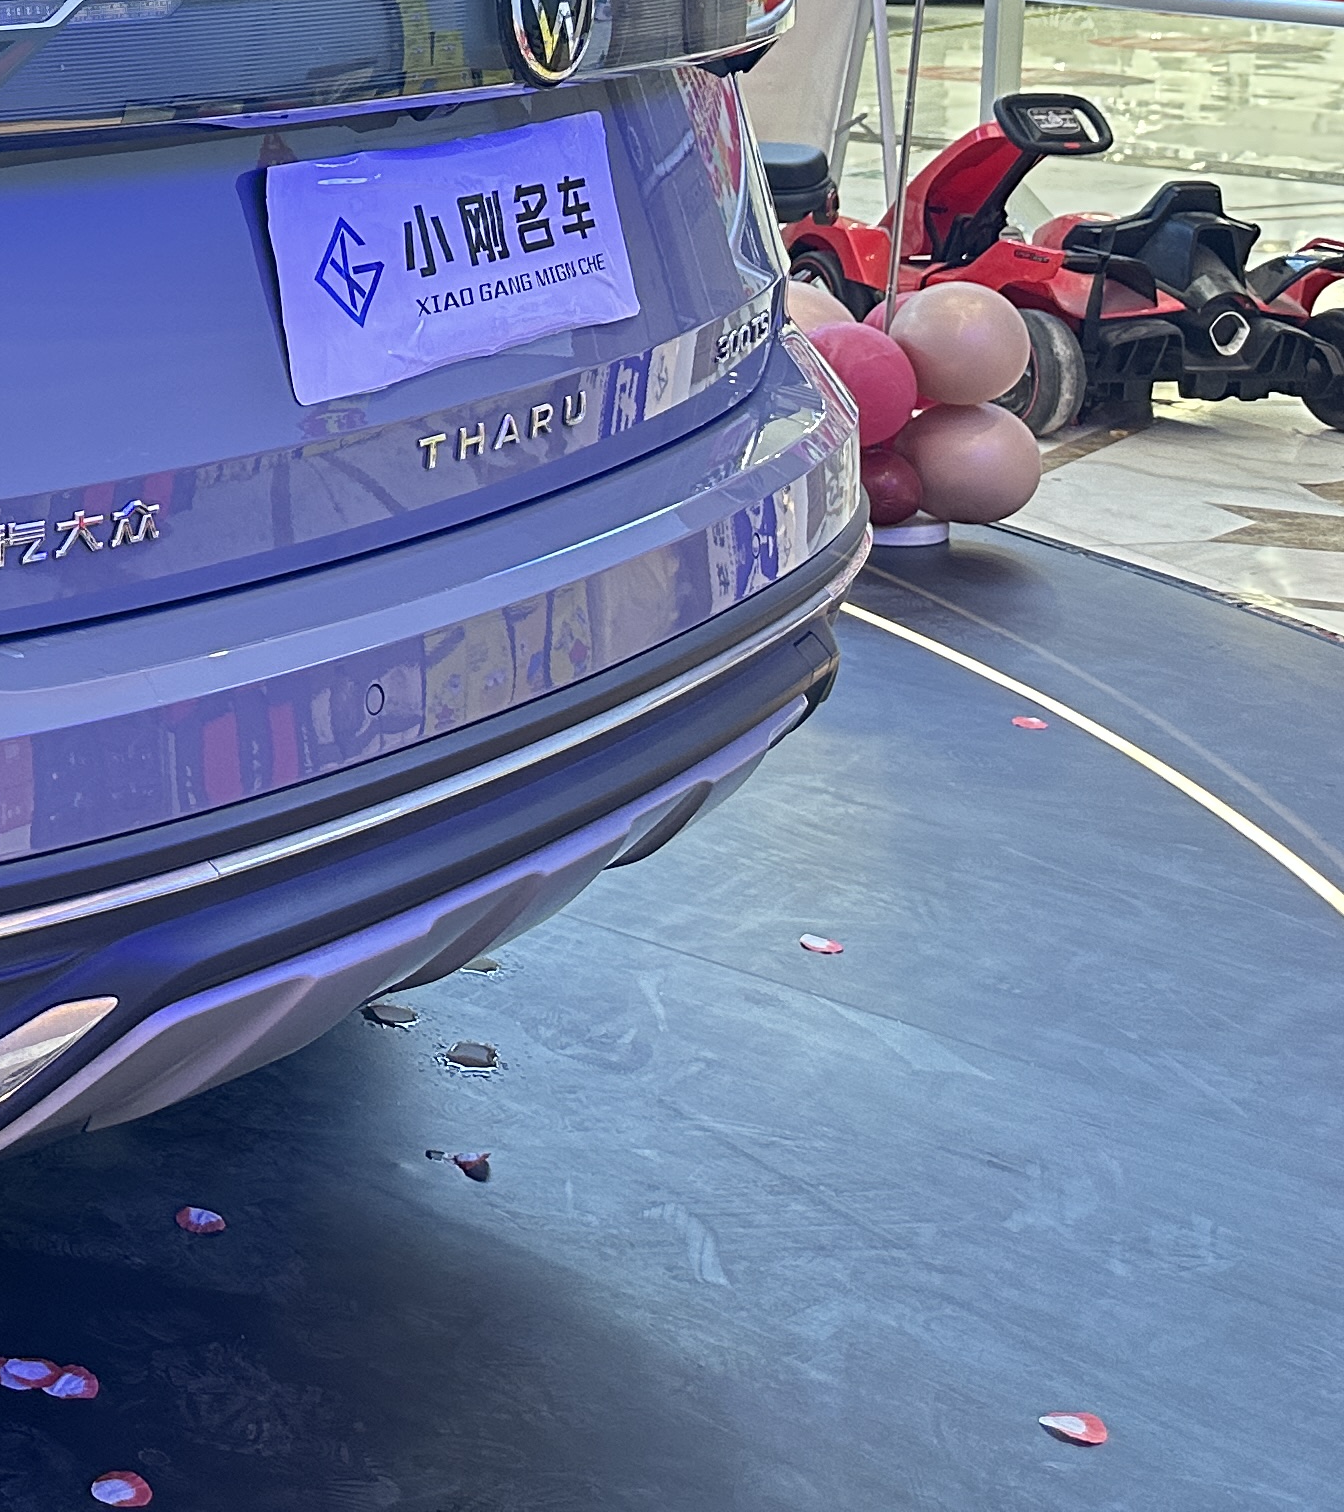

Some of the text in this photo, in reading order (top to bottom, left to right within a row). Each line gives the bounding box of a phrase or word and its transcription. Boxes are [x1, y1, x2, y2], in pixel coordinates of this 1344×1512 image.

[402, 175, 596, 278] 小刚名车
[415, 286, 474, 318] XIAO
[478, 272, 534, 304] GANG
[579, 252, 607, 276] CHE
[417, 389, 589, 471] THARU
